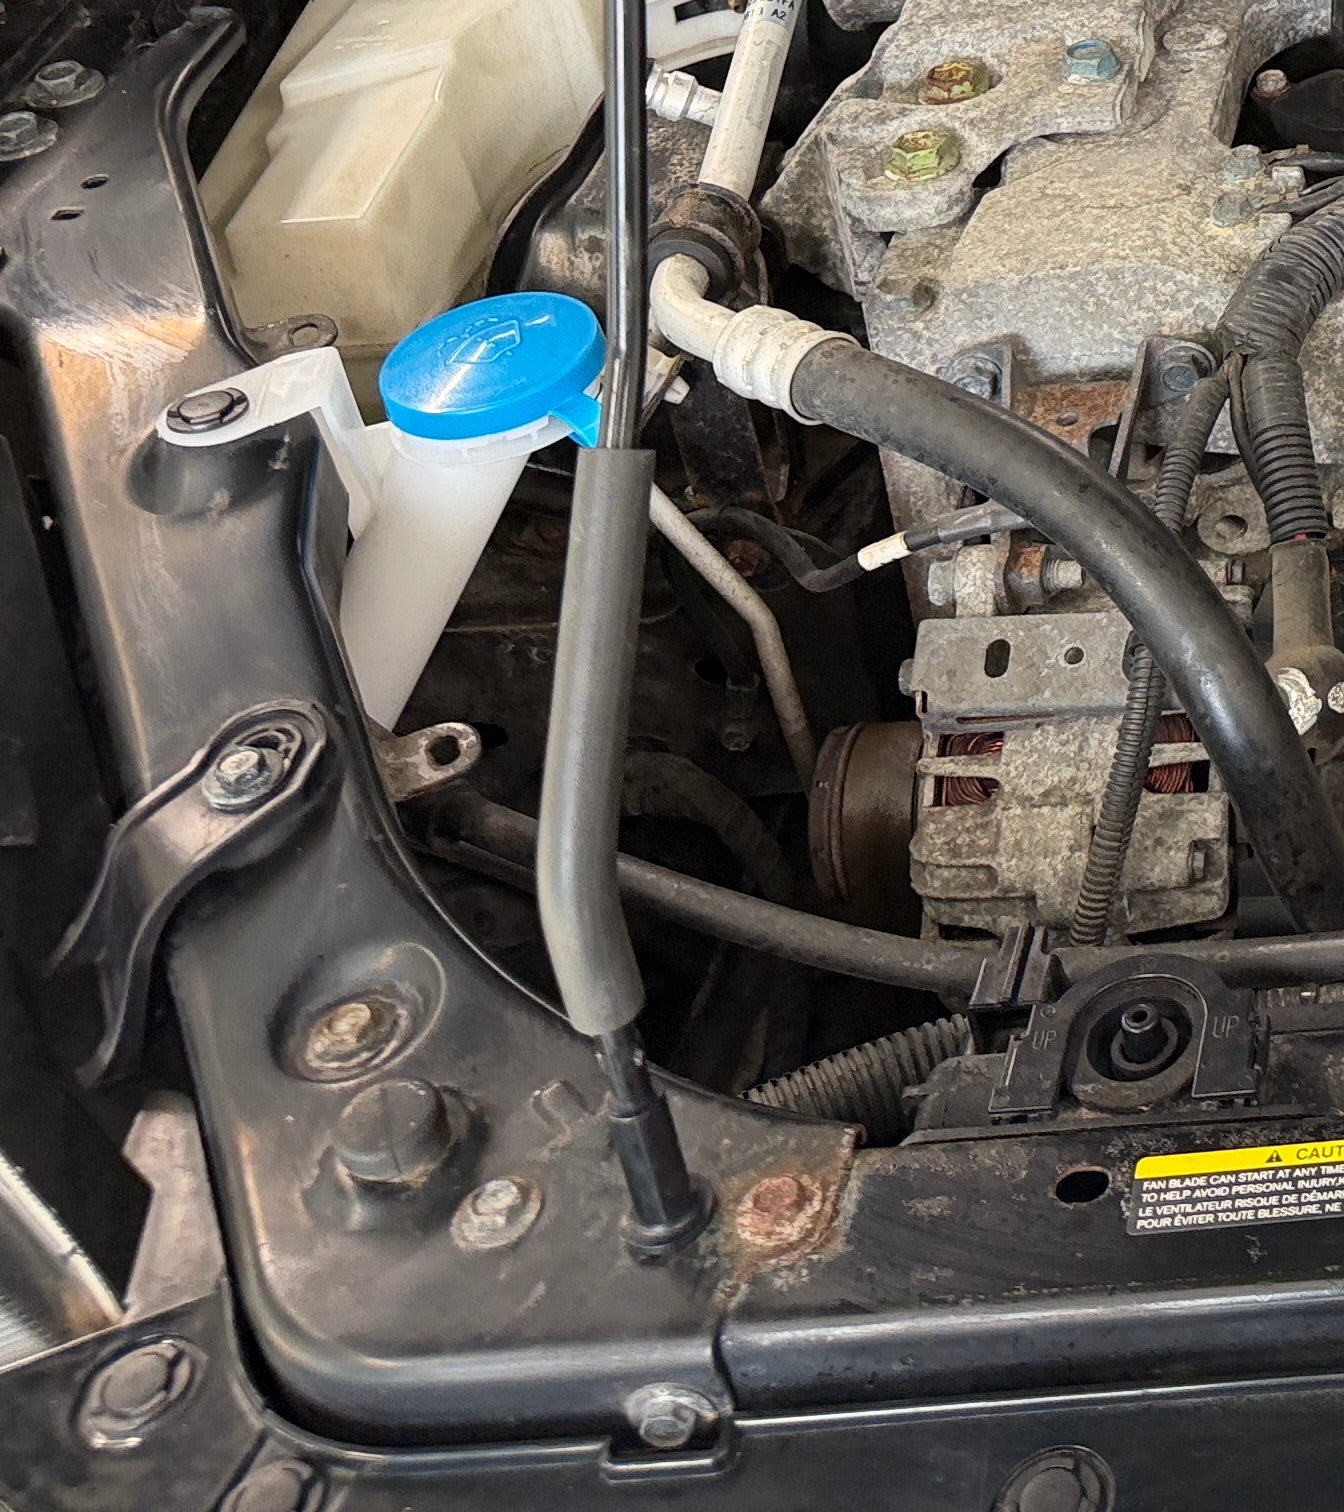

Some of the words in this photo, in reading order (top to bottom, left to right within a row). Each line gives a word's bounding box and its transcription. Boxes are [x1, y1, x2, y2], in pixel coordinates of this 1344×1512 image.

[1212, 1015, 1239, 1038] UP
[1032, 1030, 1057, 1050] UP
[1142, 1179, 1166, 1191] FAN
[1168, 1176, 1207, 1189] BLADE
[1210, 1173, 1236, 1186] CAN
[1238, 1170, 1275, 1182] START
[1276, 1169, 1292, 1179] AT
[1293, 1166, 1318, 1178] ANY
[1141, 1192, 1158, 1203] TO
[1160, 1189, 1192, 1201] HELP
[1192, 1186, 1229, 1199] AVOID
[1232, 1181, 1295, 1195] PERSONAL
[1136, 1218, 1171, 1230] POUR
[1174, 1213, 1215, 1227] ÉVITER
[1217, 1209, 1255, 1222] TOUTE
[1258, 1204, 1322, 1219] BLESSURE,
[1325, 1202, 1342, 1213] NE
[1138, 1207, 1154, 1217] LE
[1156, 1199, 1233, 1216] VENTILATEUR
[1235, 1195, 1279, 1209] RISQUE
[1282, 1194, 1298, 1205] DE
